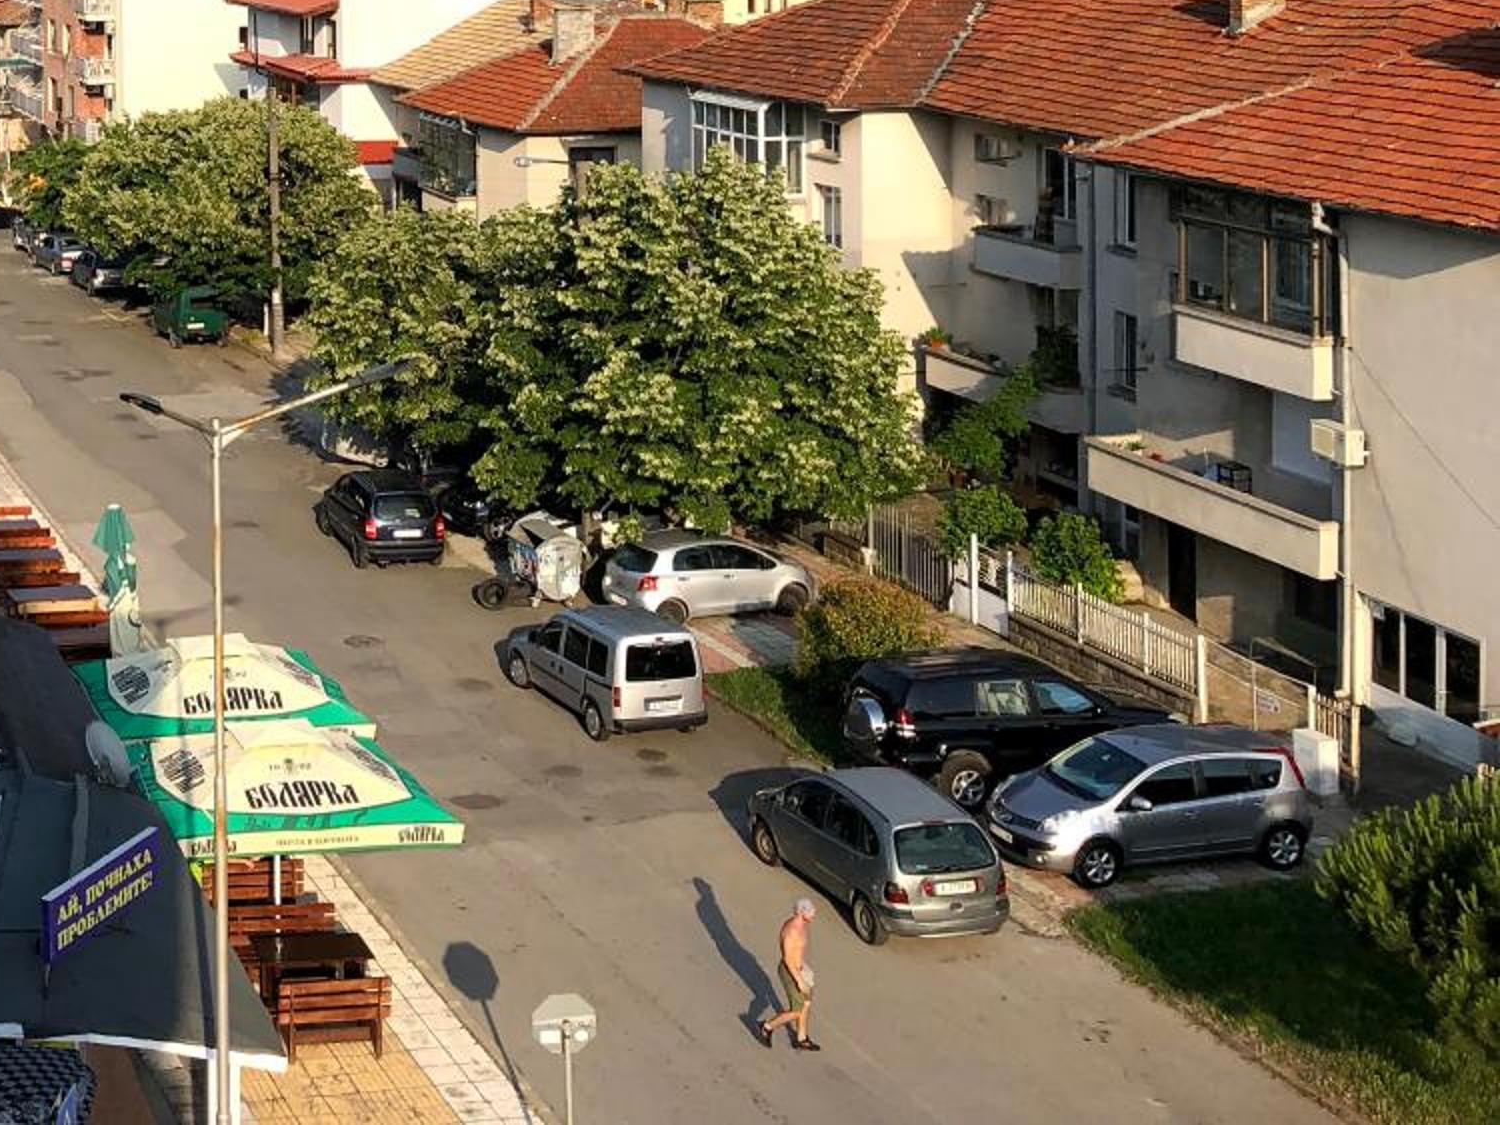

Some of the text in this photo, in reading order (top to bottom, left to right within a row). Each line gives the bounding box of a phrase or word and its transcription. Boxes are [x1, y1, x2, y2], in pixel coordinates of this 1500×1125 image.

[245, 779, 360, 809] БОЛЯРКА
[57, 892, 83, 926] АЙ,
[57, 870, 153, 951] ПРОБЛЕМИТЕ!
